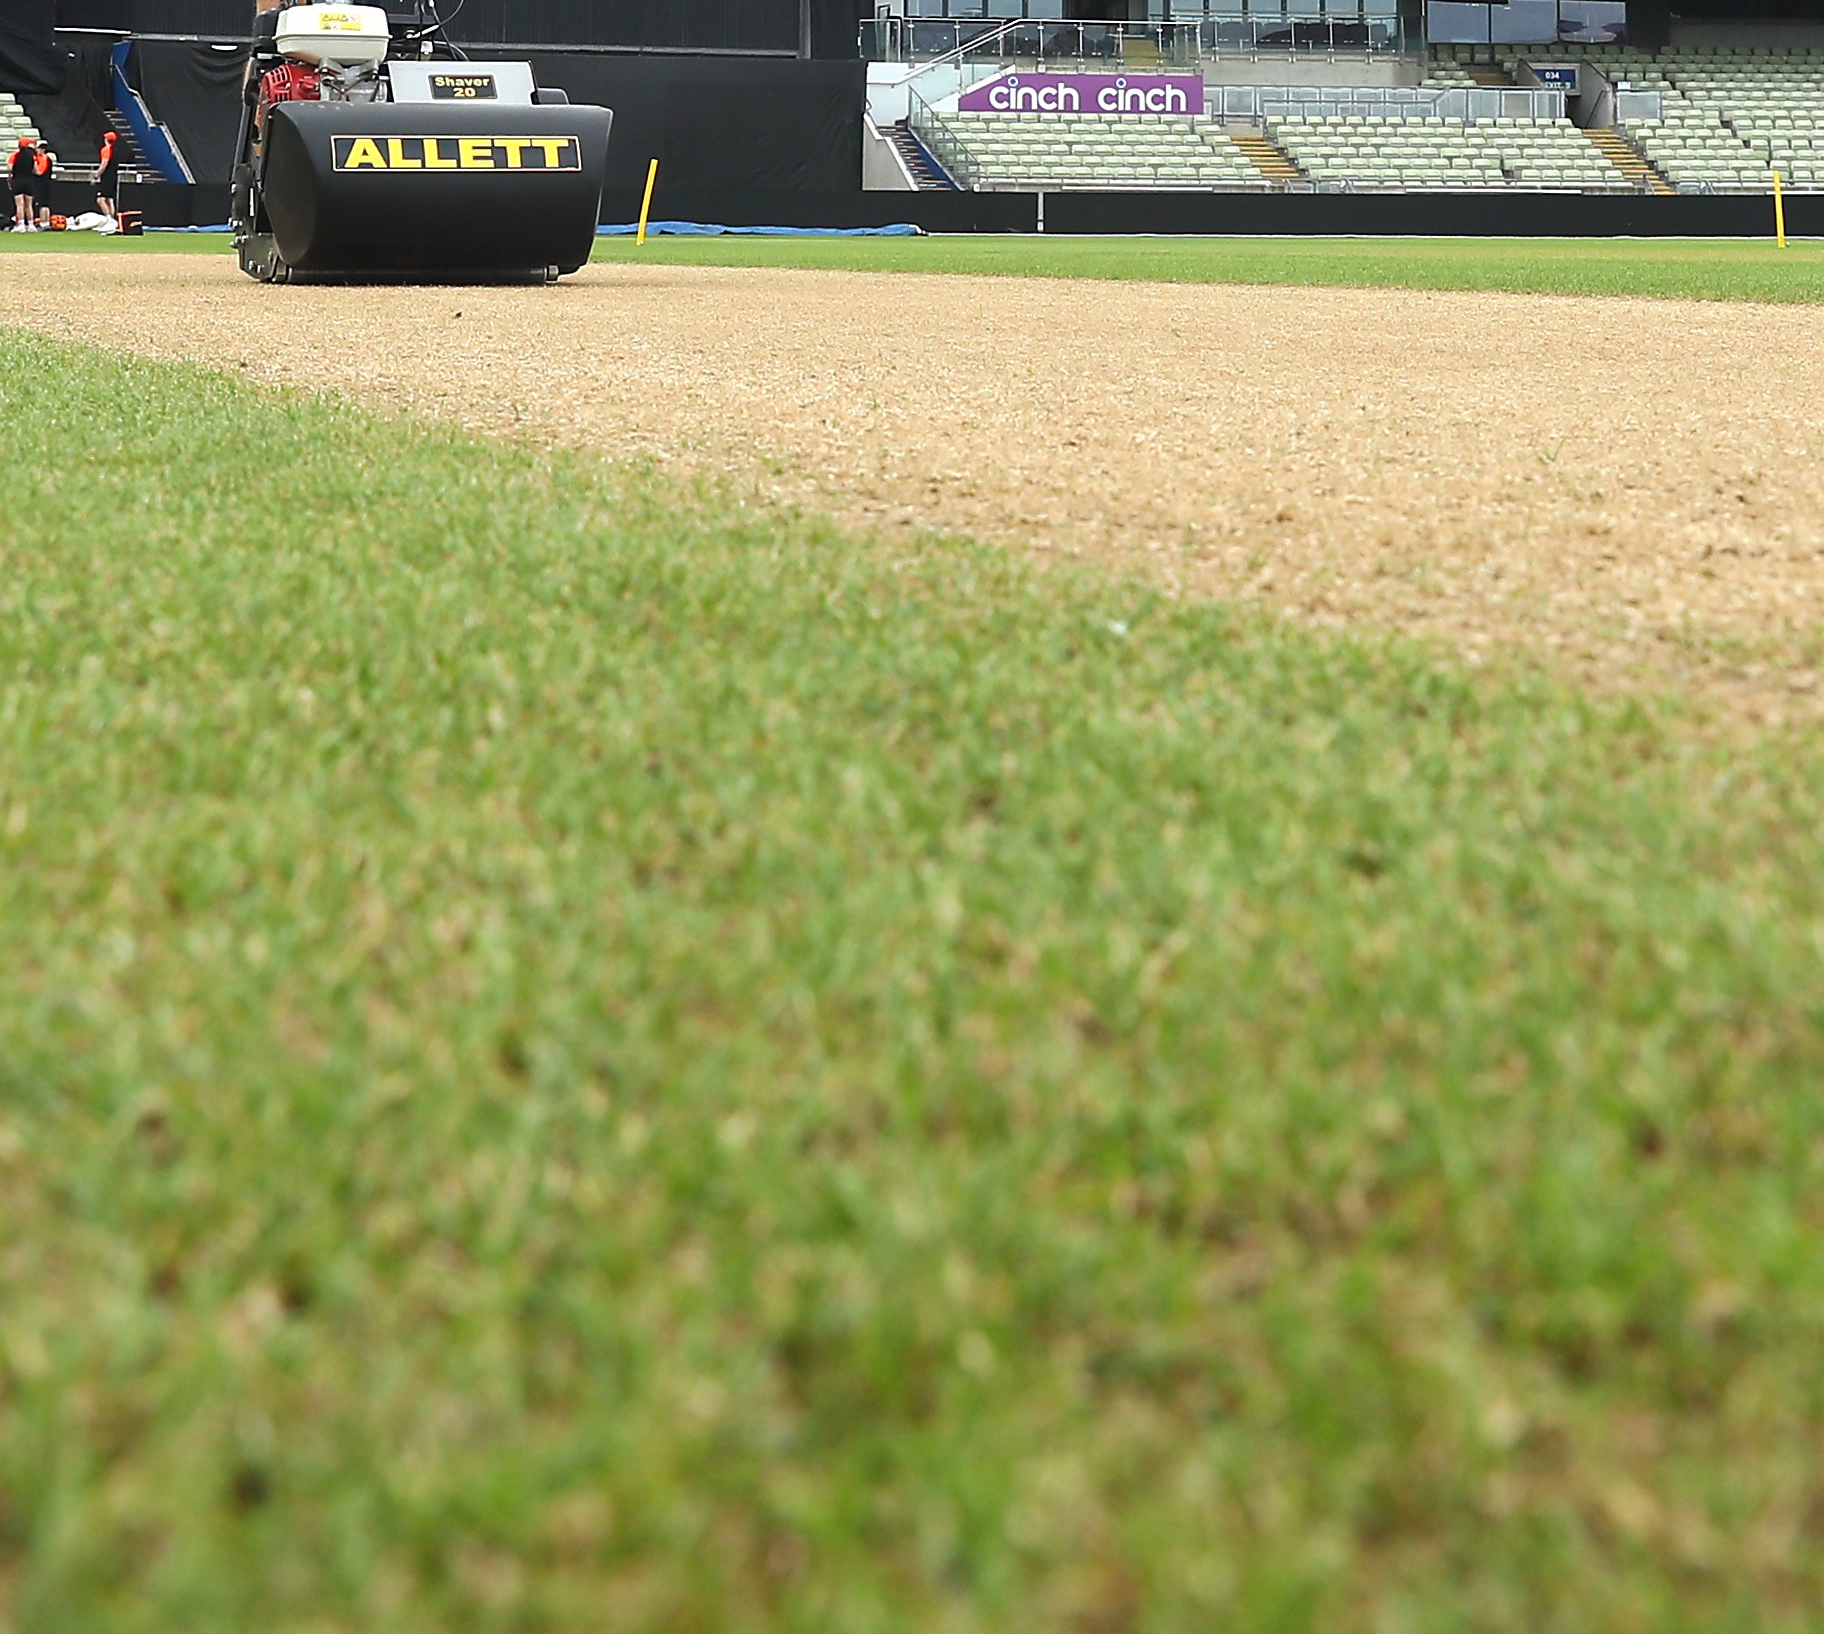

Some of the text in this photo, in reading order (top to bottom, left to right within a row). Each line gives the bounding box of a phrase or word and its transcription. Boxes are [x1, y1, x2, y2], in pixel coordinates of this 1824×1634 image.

[435, 77, 489, 88] Shaver
[453, 88, 475, 98] 20
[990, 76, 1079, 110] cinch
[1098, 78, 1186, 111] cinch
[345, 139, 568, 167] ALLETT
